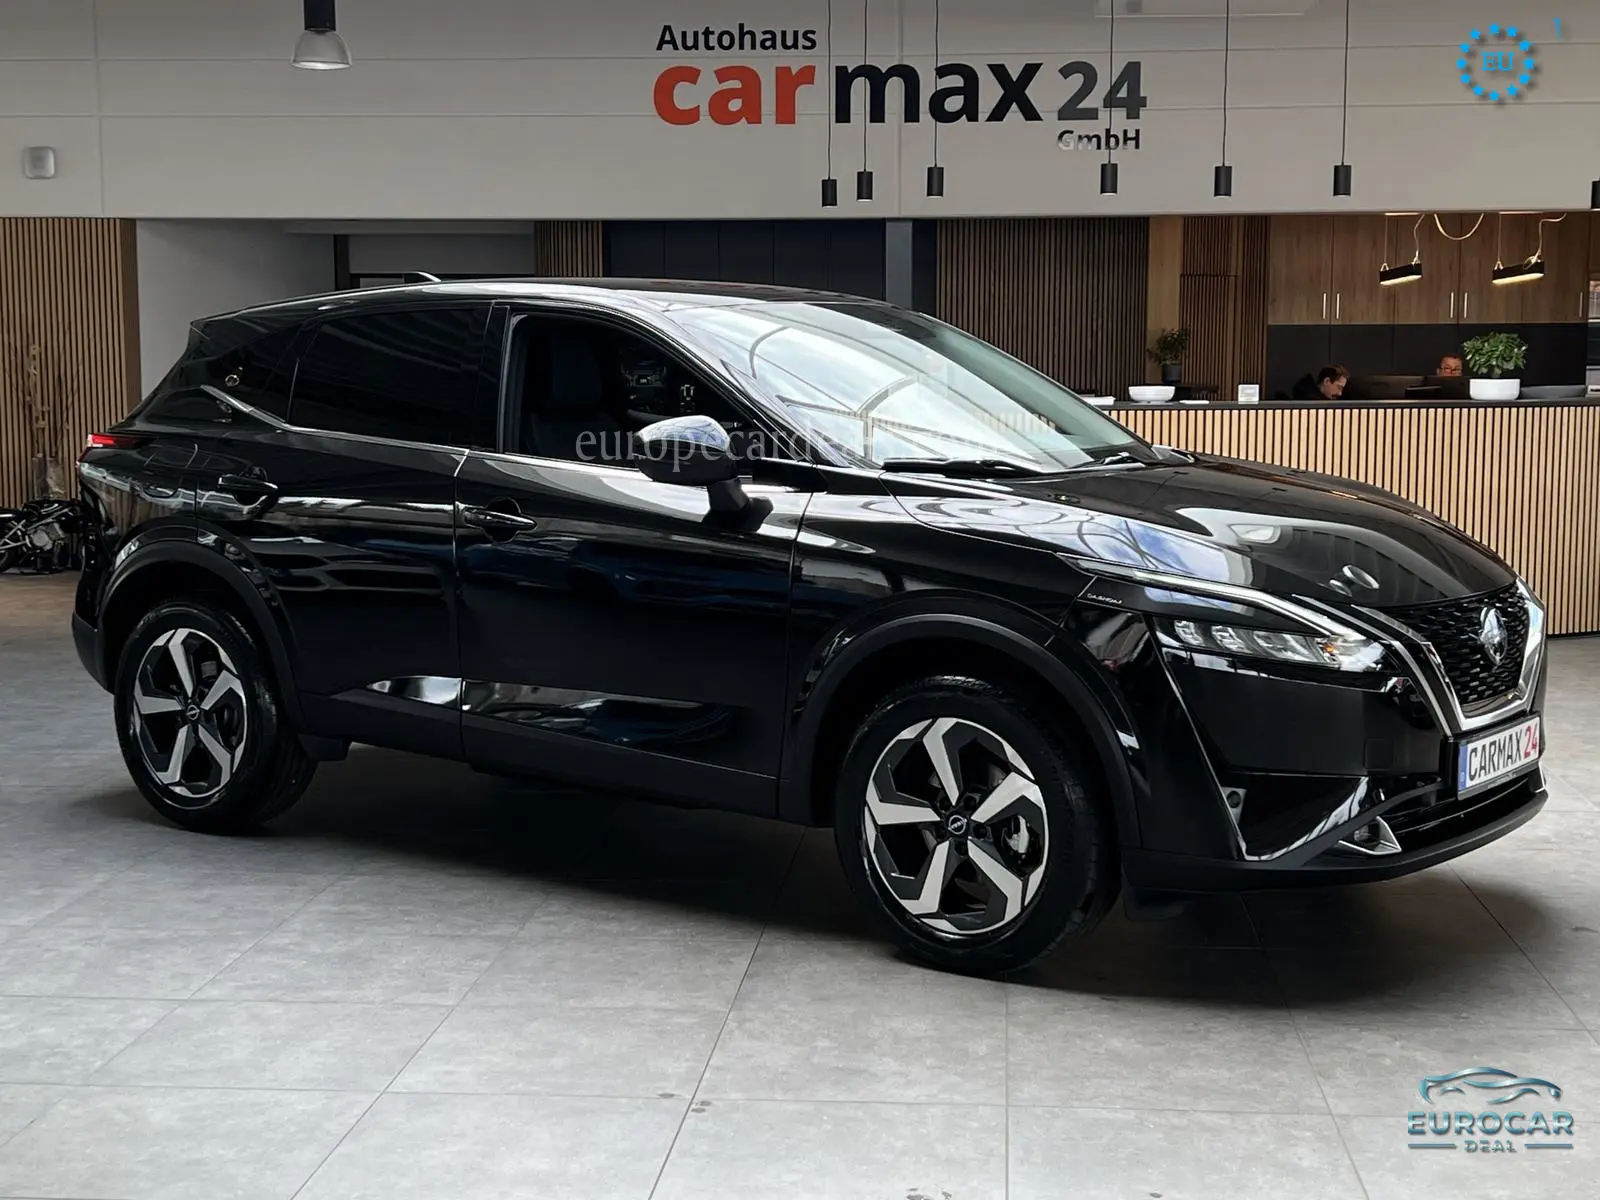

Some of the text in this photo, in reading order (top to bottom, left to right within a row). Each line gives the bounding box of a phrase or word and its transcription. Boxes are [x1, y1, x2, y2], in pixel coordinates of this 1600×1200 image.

[655, 23, 817, 51] Autohaus
[1057, 60, 1147, 121] 24
[1057, 128, 1140, 150] GmbH
